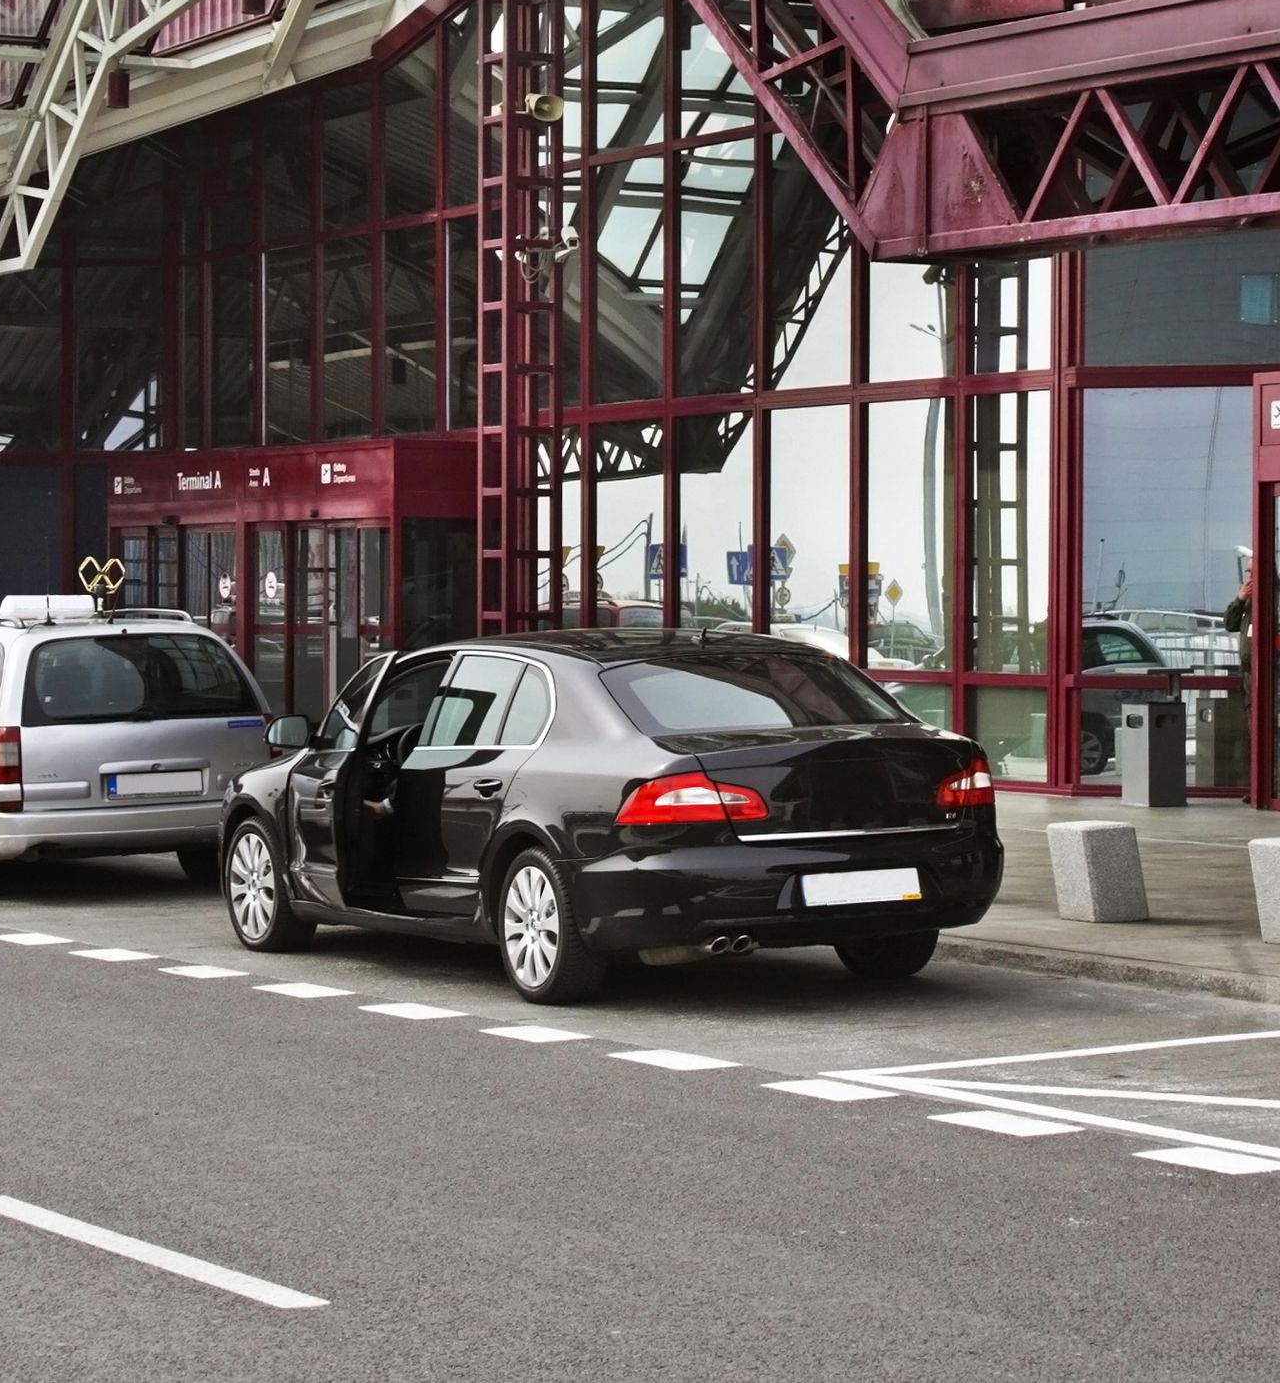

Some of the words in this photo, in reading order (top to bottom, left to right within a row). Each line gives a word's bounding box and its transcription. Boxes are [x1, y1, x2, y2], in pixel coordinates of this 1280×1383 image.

[176, 470, 213, 491] Terminal
[214, 470, 222, 489] A
[262, 467, 271, 487] A
